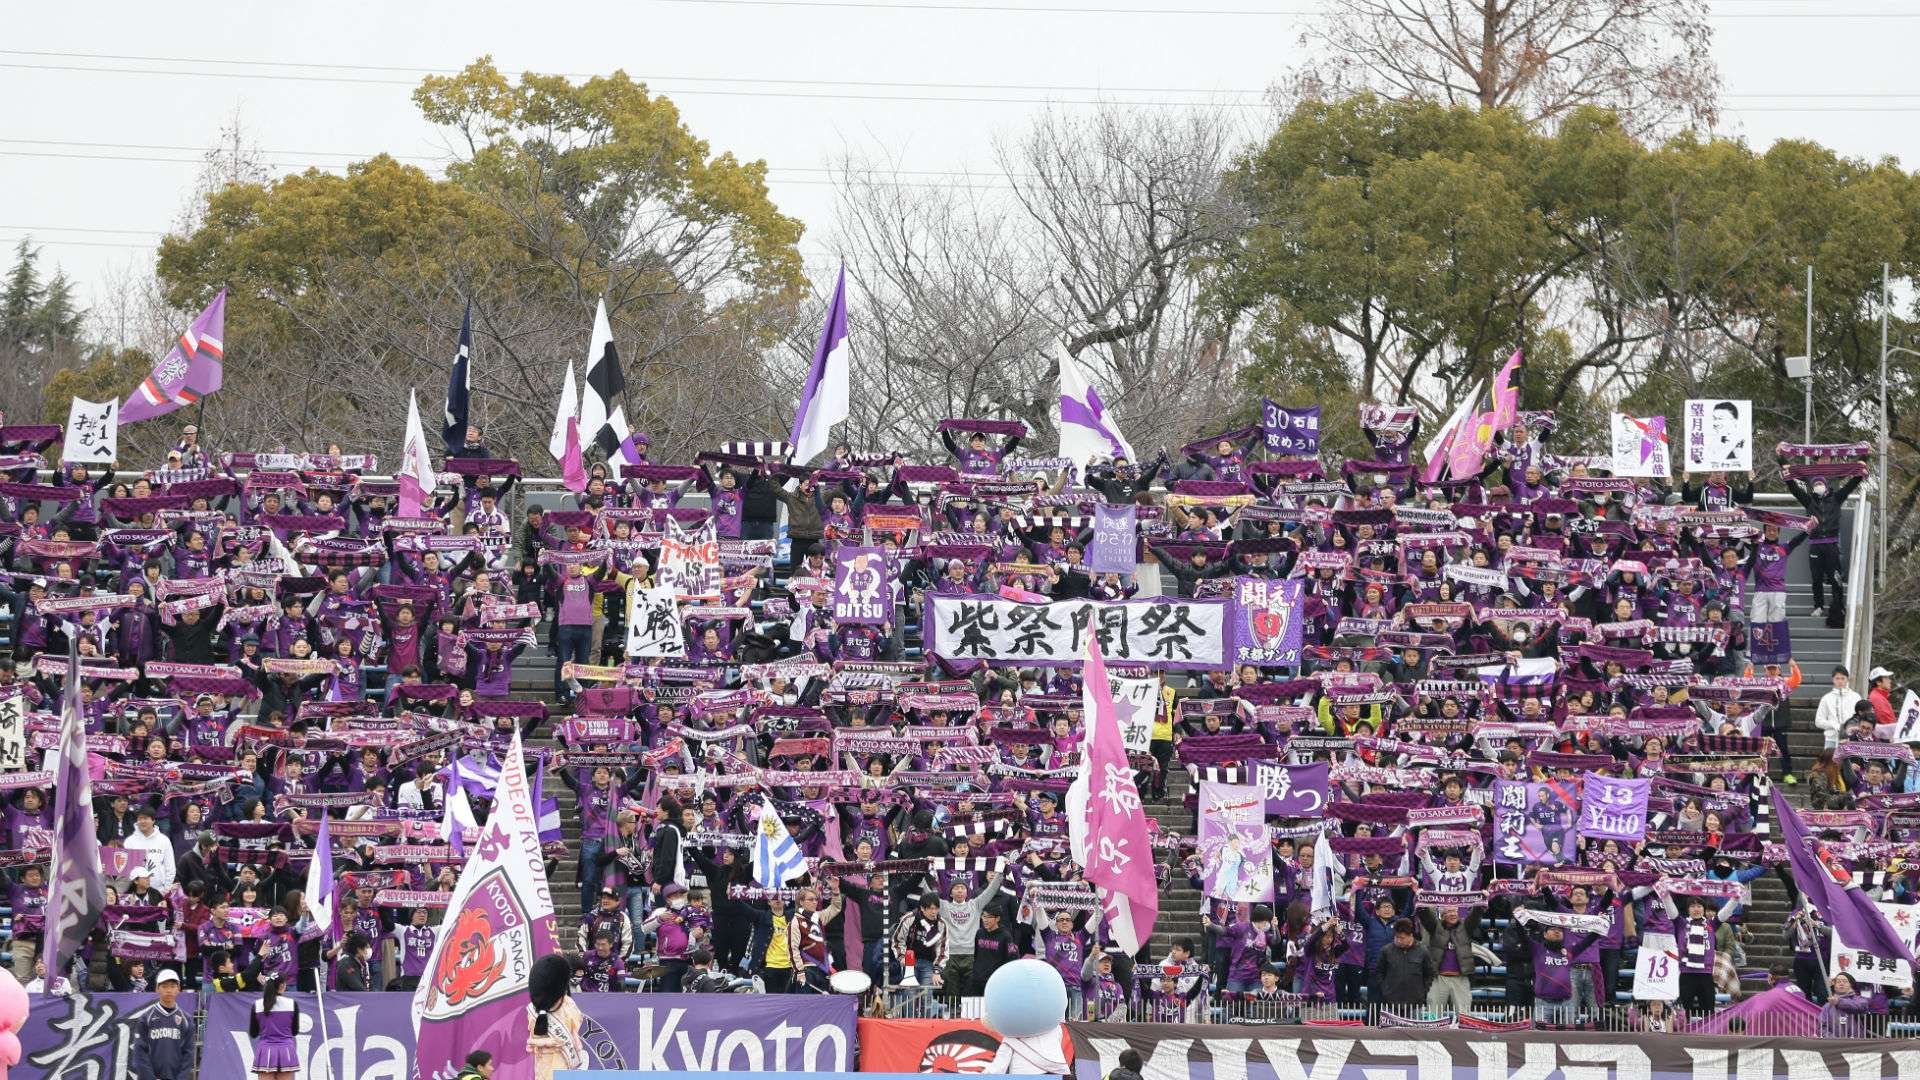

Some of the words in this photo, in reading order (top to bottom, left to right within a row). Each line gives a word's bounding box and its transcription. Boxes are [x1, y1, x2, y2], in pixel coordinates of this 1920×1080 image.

[1266, 405, 1289, 430] 30
[836, 603, 883, 618] BITSU
[859, 647, 871, 657] 30
[1238, 646, 1299, 662] 京都サンガ
[844, 663, 872, 672] KYOTO
[873, 664, 900, 673] SANGA
[656, 688, 698, 698] VAMOS
[588, 719, 609, 729] KYOTO
[588, 727, 609, 736] SANGA
[1123, 722, 1148, 746] 都
[850, 740, 879, 750] KYOTO
[880, 741, 911, 750] SANGA
[1255, 764, 1321, 812] 勝つ
[1601, 784, 1633, 805] 13
[1428, 809, 1457, 819] SANGA
[1590, 804, 1639, 835] Yuto
[1500, 785, 1526, 859] 闘莉王
[486, 881, 517, 927] KYOTO
[1352, 932, 1364, 944] 22
[509, 929, 526, 983] SANGA
[1068, 951, 1079, 962] 22
[1648, 955, 1669, 979] 13
[1259, 992, 1303, 1001] VAMOS
